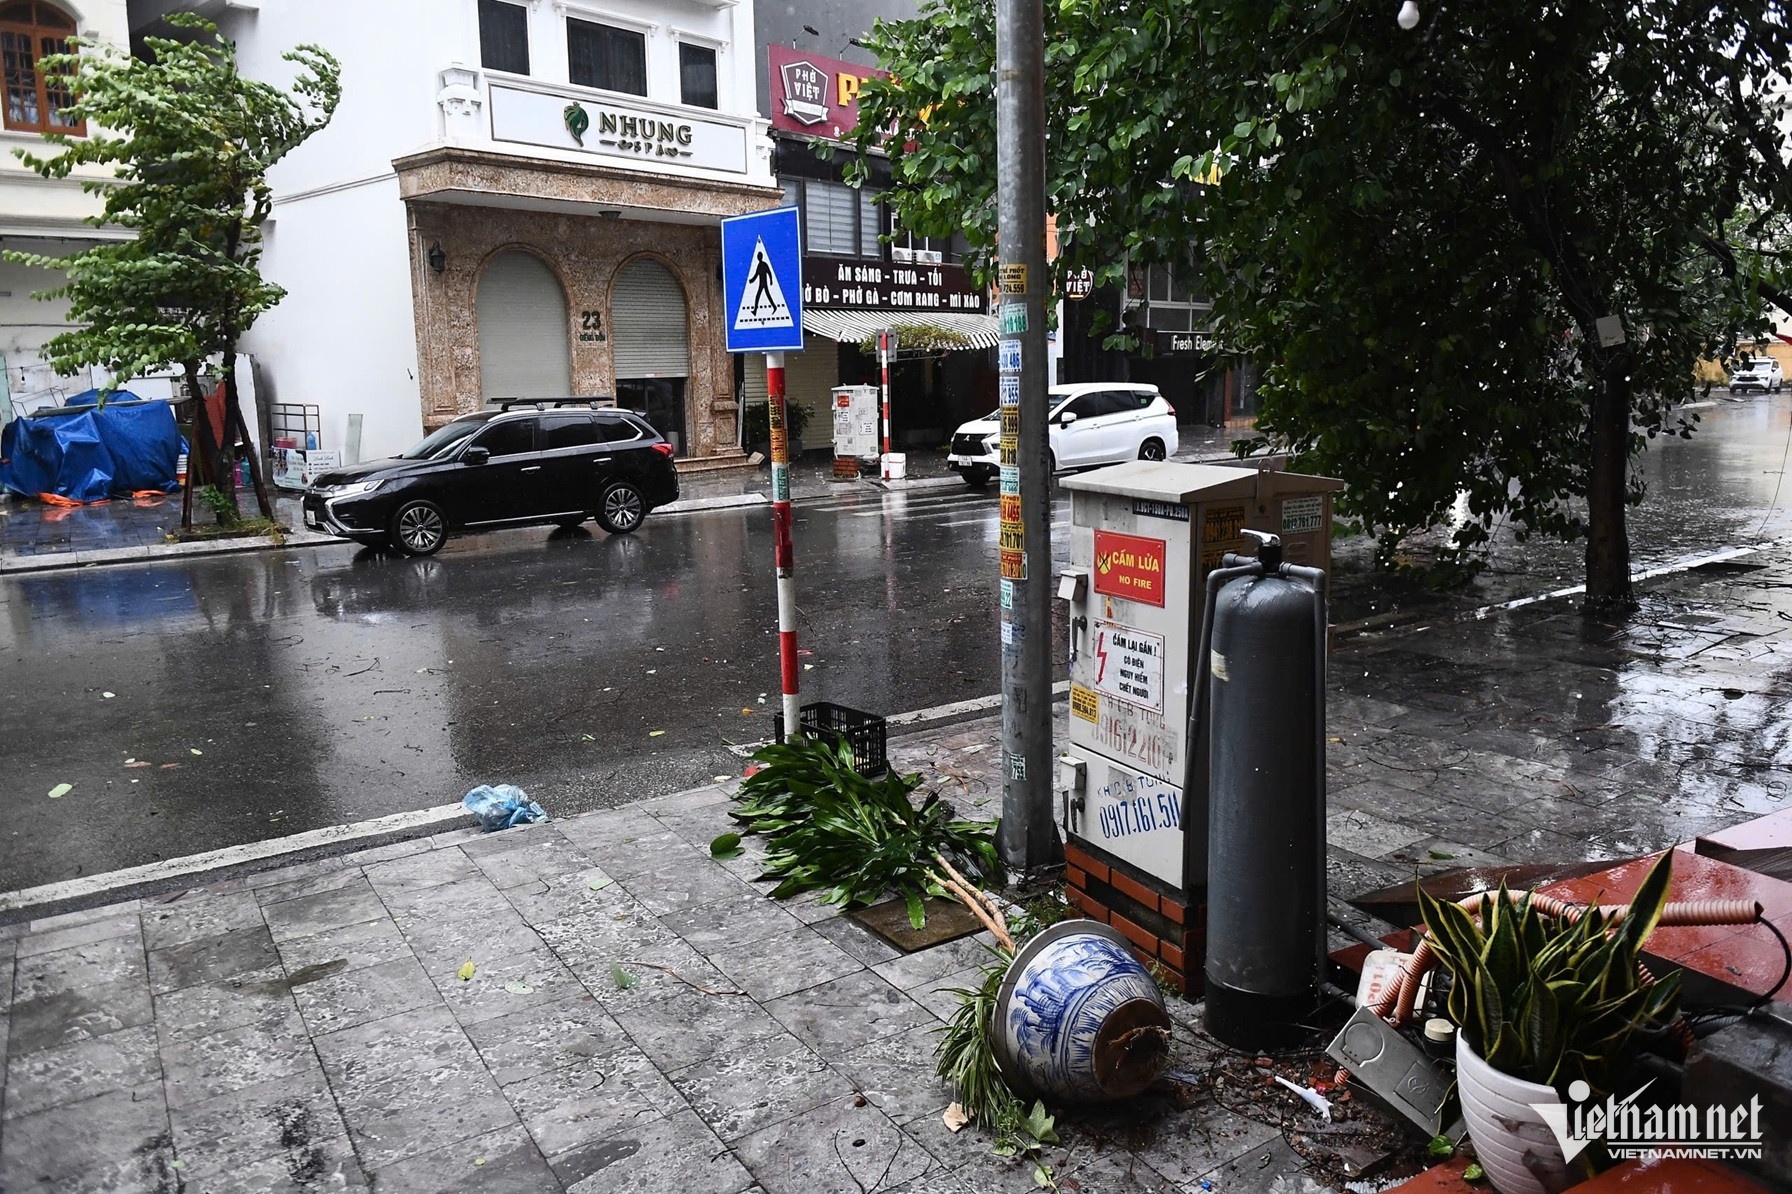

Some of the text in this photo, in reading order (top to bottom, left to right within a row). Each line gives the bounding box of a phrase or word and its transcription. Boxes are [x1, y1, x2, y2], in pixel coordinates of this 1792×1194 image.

[795, 68, 816, 83] PHỞ
[793, 81, 820, 101] VIỆT
[598, 111, 693, 146] NHUNG
[633, 140, 666, 157] SPA
[838, 263, 852, 282] ĂN
[854, 265, 882, 284] SÁNG
[893, 269, 918, 286] TRƯA
[927, 267, 943, 287] TỐI
[1066, 279, 1090, 295] VIỆT
[815, 285, 830, 304] BÒ
[842, 285, 863, 305] PHỞ
[865, 287, 880, 305] GÀ
[890, 291, 913, 307] CƠM
[915, 292, 940, 307] RANG
[949, 291, 962, 309] MÌ
[963, 292, 980, 309] XÀO
[581, 310, 601, 330] 23
[1172, 334, 1193, 351] Fresh
[1112, 548, 1160, 572] CẤM LỬA
[1119, 574, 1152, 590] NO FIRE
[1112, 632, 1127, 649] CẤM
[1120, 668, 1134, 680] NGUY
[1119, 682, 1132, 694] CHẾT
